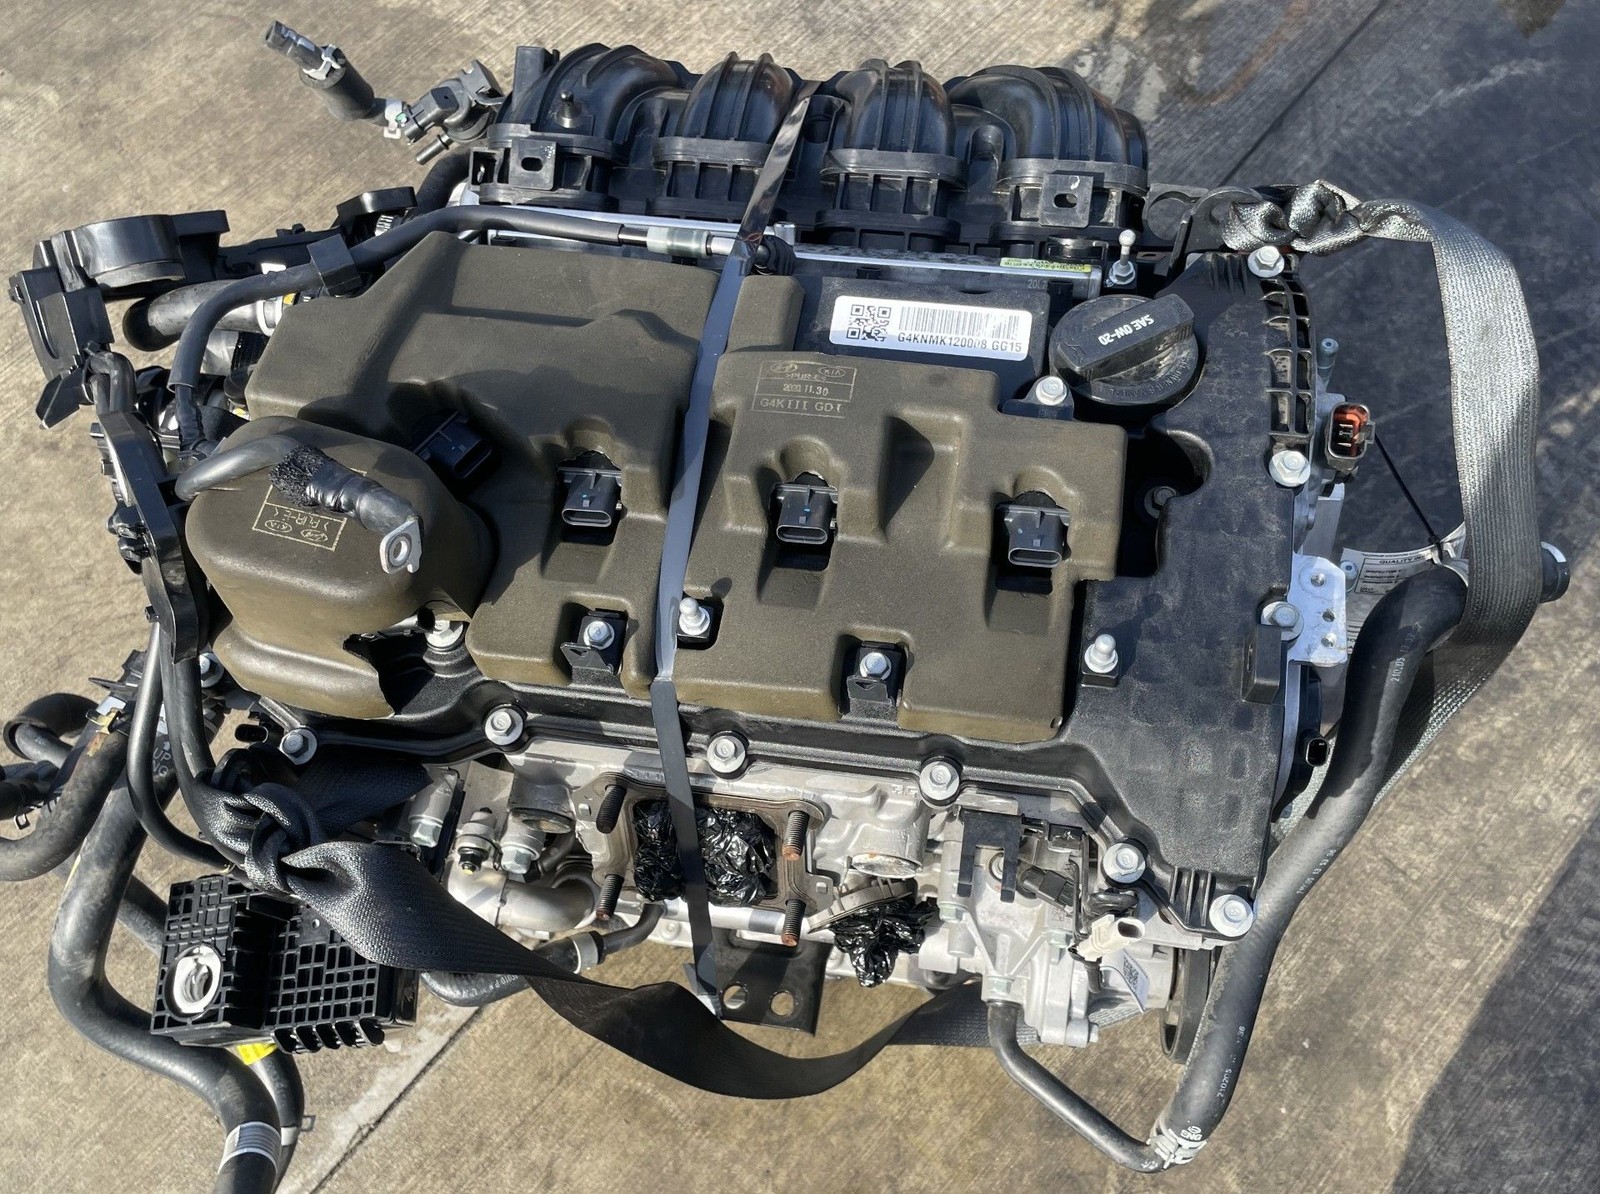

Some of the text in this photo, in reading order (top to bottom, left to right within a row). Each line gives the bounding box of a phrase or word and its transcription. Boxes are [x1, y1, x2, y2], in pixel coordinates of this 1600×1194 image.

[1097, 314, 1155, 346] SAE 0W-20
[991, 340, 1022, 352] GG15
[1379, 557, 1412, 565] QUALITY
[153, 747, 172, 762] UP
